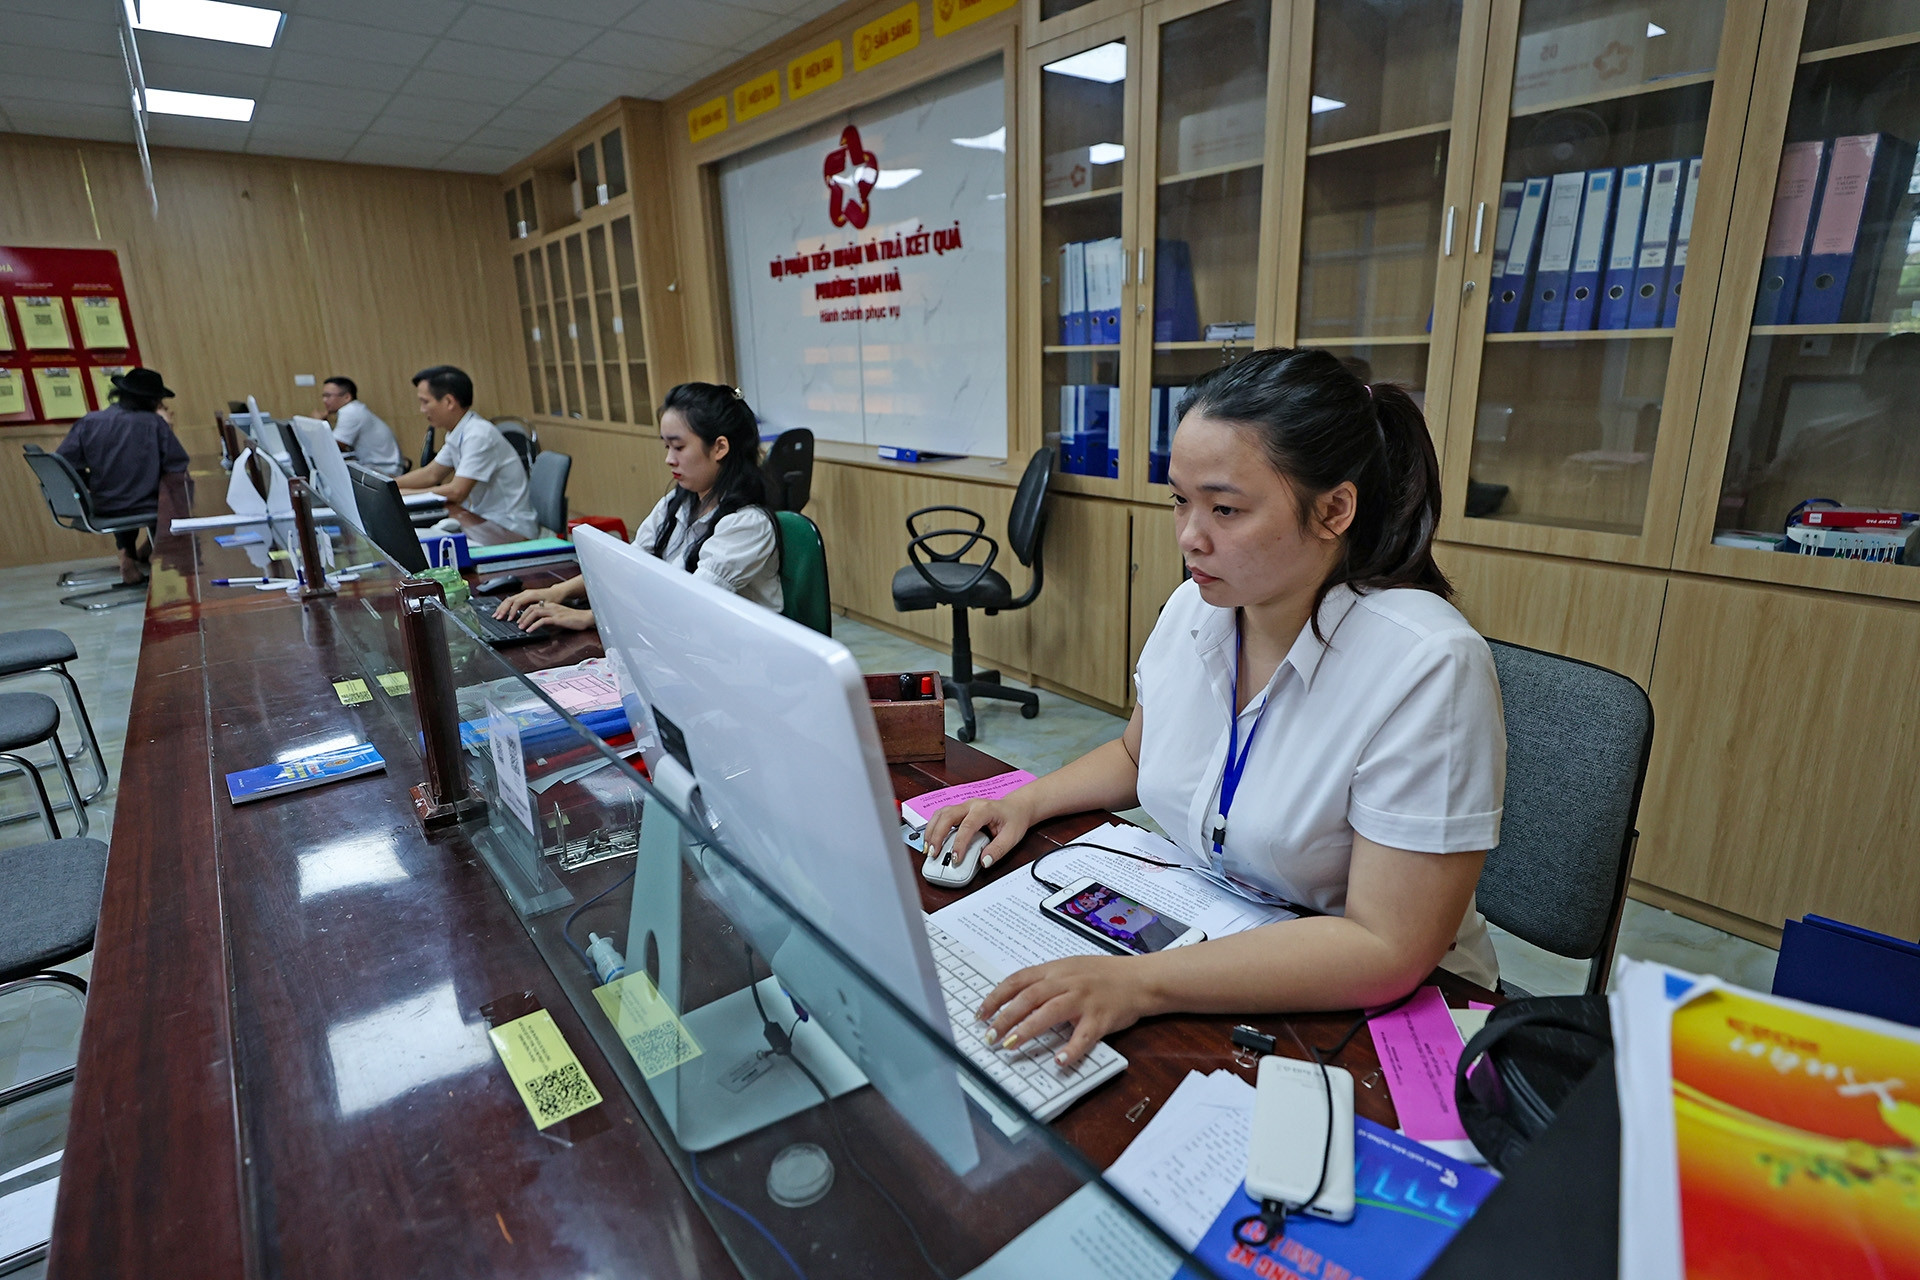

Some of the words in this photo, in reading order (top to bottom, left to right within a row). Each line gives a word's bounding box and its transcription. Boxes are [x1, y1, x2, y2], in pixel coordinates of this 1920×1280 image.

[879, 232, 903, 260] TRẢ
[905, 224, 930, 256] KẾT
[933, 220, 962, 256] QUẢ
[858, 273, 882, 296] NAM
[884, 266, 902, 292] HÀ
[820, 307, 839, 324] Hành
[840, 305, 863, 321] chính
[865, 304, 886, 323] phục
[889, 305, 901, 321] vụ
